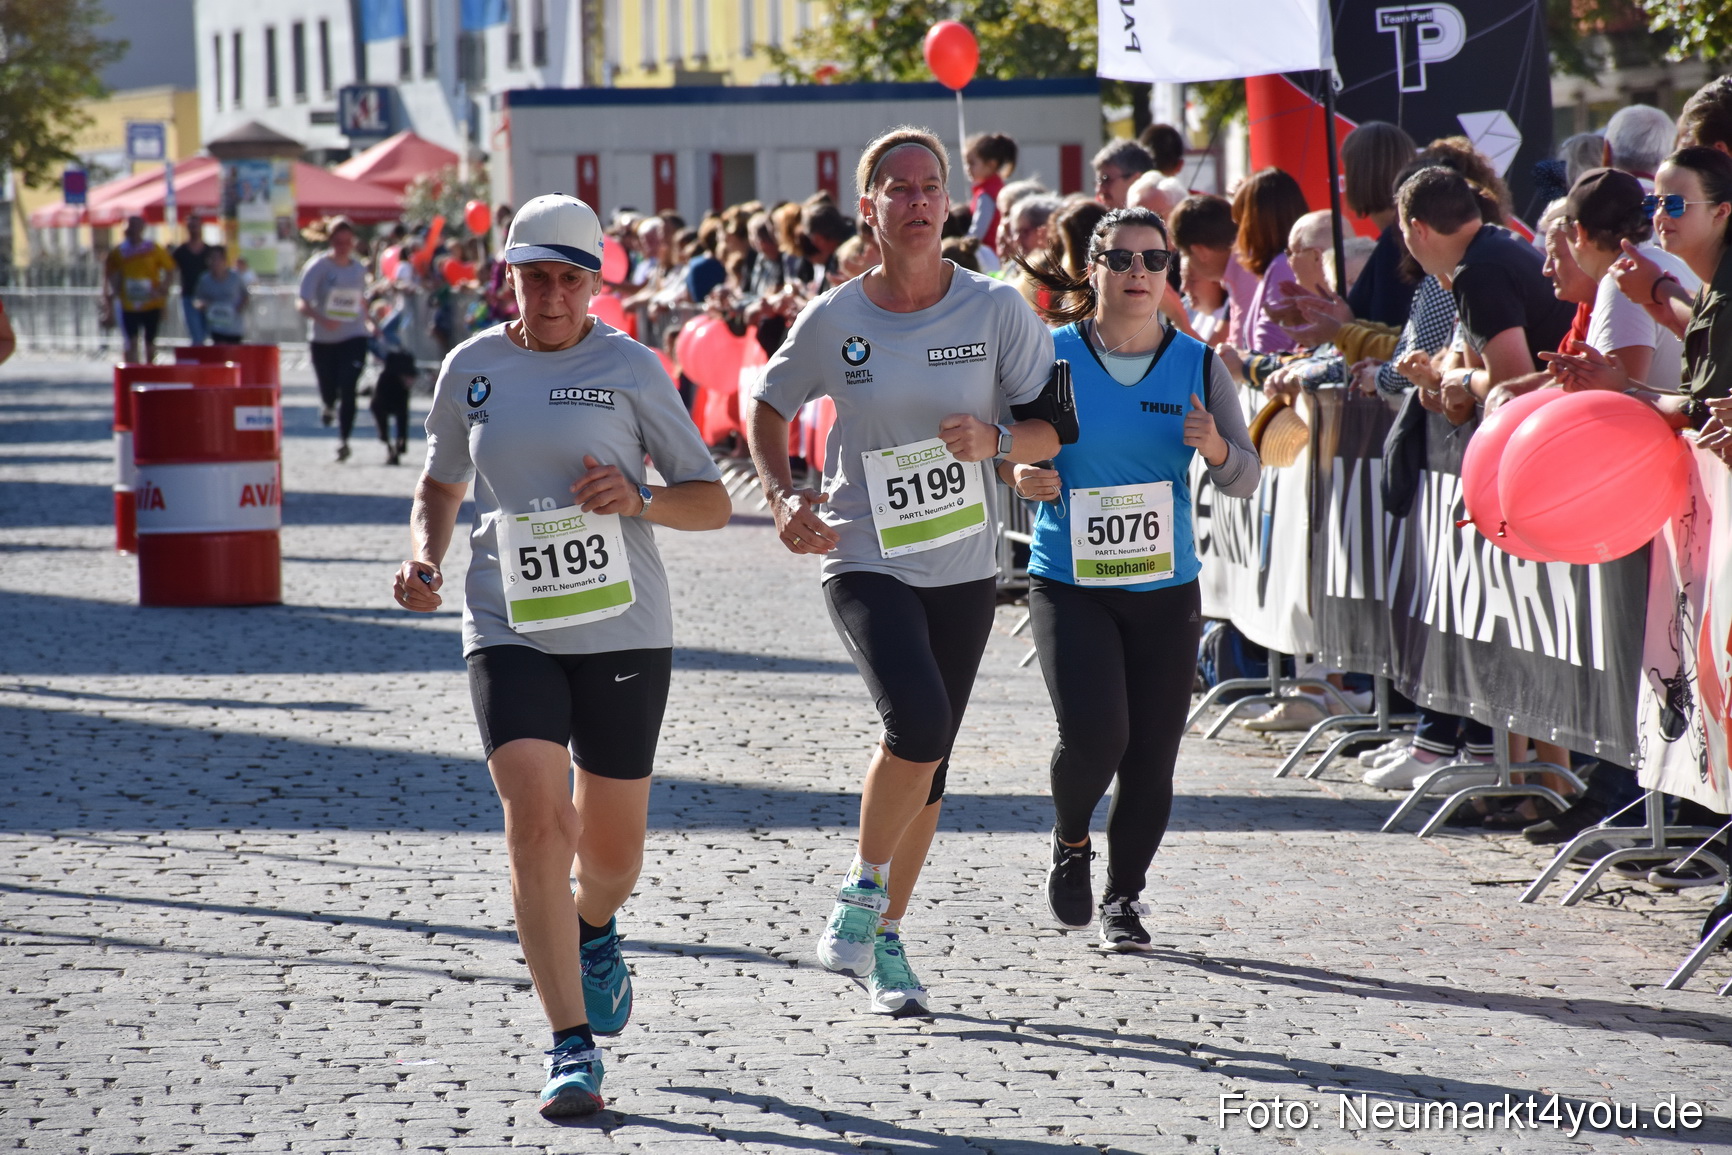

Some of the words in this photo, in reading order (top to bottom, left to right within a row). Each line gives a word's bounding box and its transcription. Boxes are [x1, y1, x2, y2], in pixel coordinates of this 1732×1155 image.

[1383, 13, 1409, 24] Team
[928, 342, 986, 362] BOCK
[845, 369, 873, 379] PARTL
[550, 388, 614, 405] BOCK
[468, 410, 489, 420] PARTL
[1140, 401, 1183, 416] THULE
[896, 445, 945, 467] BOCK
[887, 462, 966, 510] 5199
[1101, 493, 1144, 507] BOCK
[900, 510, 924, 520] PARTL
[925, 502, 956, 516] Neumarkt
[531, 515, 585, 535] BOCK
[1087, 511, 1160, 546] 5076
[519, 534, 609, 581] 5193
[1118, 547, 1148, 555] Neumarkt
[1096, 559, 1155, 577] Stephanie
[532, 584, 558, 593] PARTL
[559, 578, 597, 591] Neumarkt
